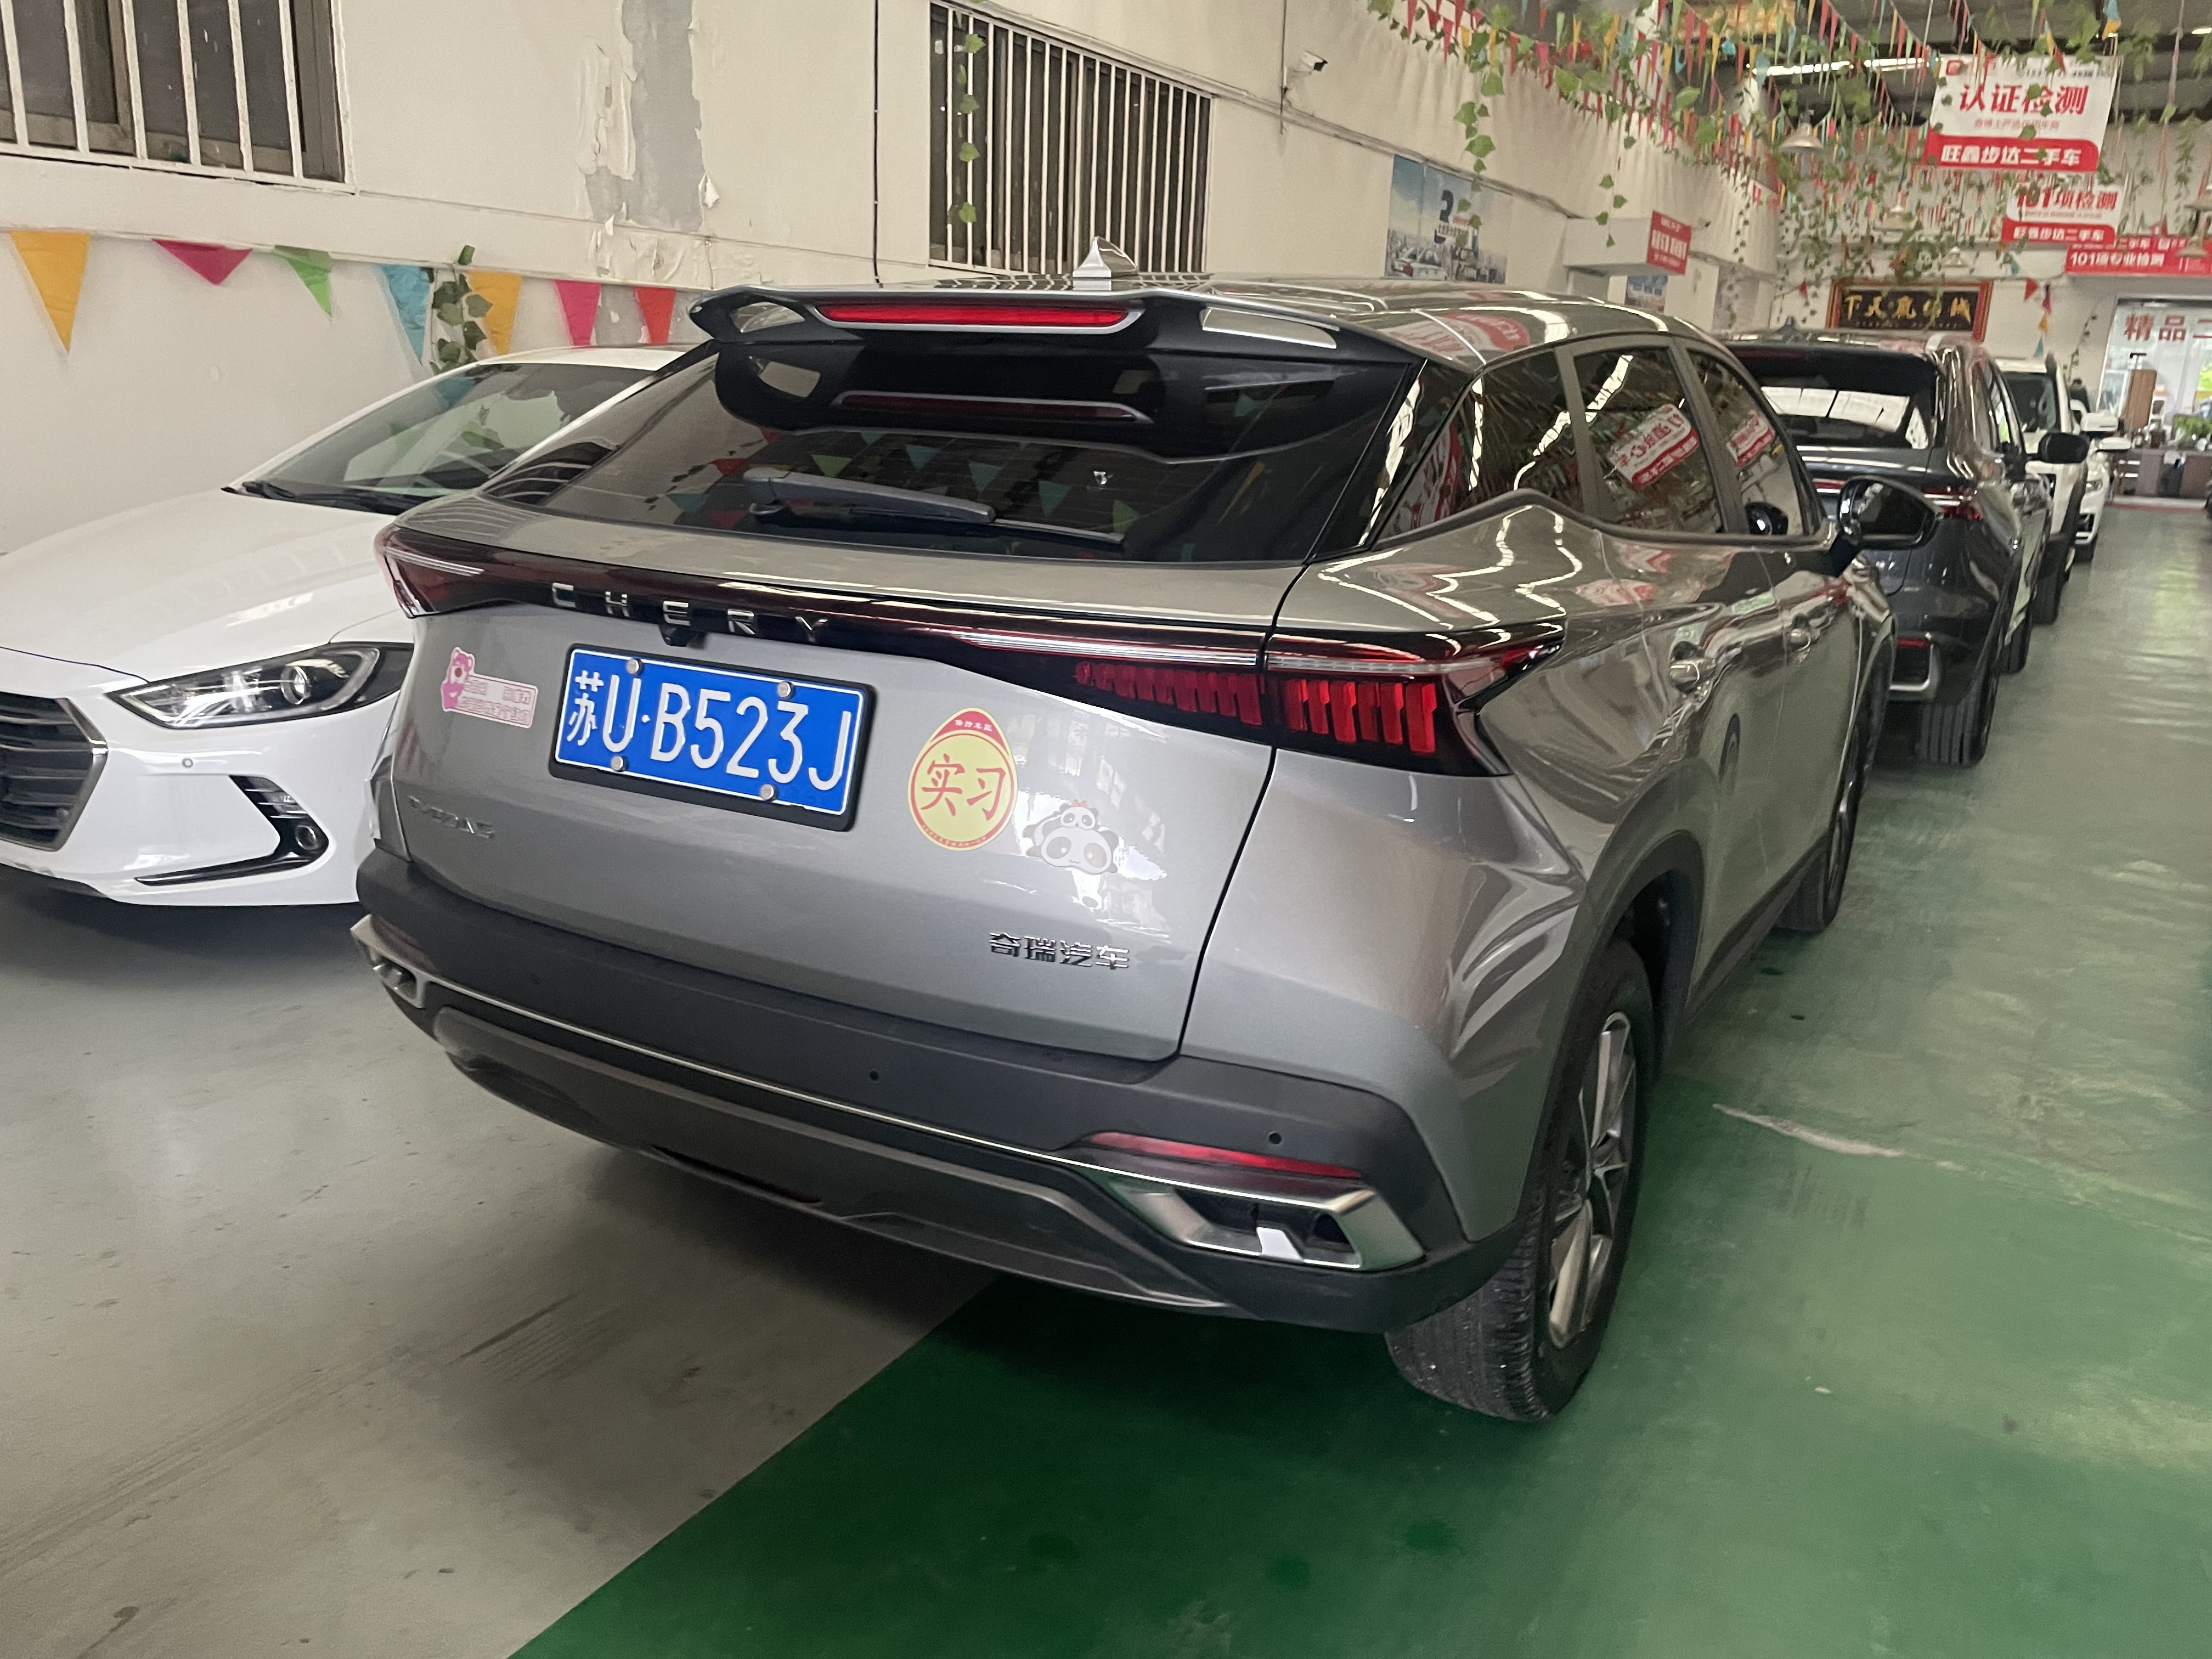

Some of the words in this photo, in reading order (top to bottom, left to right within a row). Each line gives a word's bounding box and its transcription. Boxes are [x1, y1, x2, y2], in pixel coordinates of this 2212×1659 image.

[1960, 83, 2089, 115] 认证检测
[552, 582, 828, 642] CHERY
[567, 670, 851, 791] 苏U·B523J
[920, 753, 1006, 821] 实习
[989, 932, 1128, 970] 奇瑞汽车
